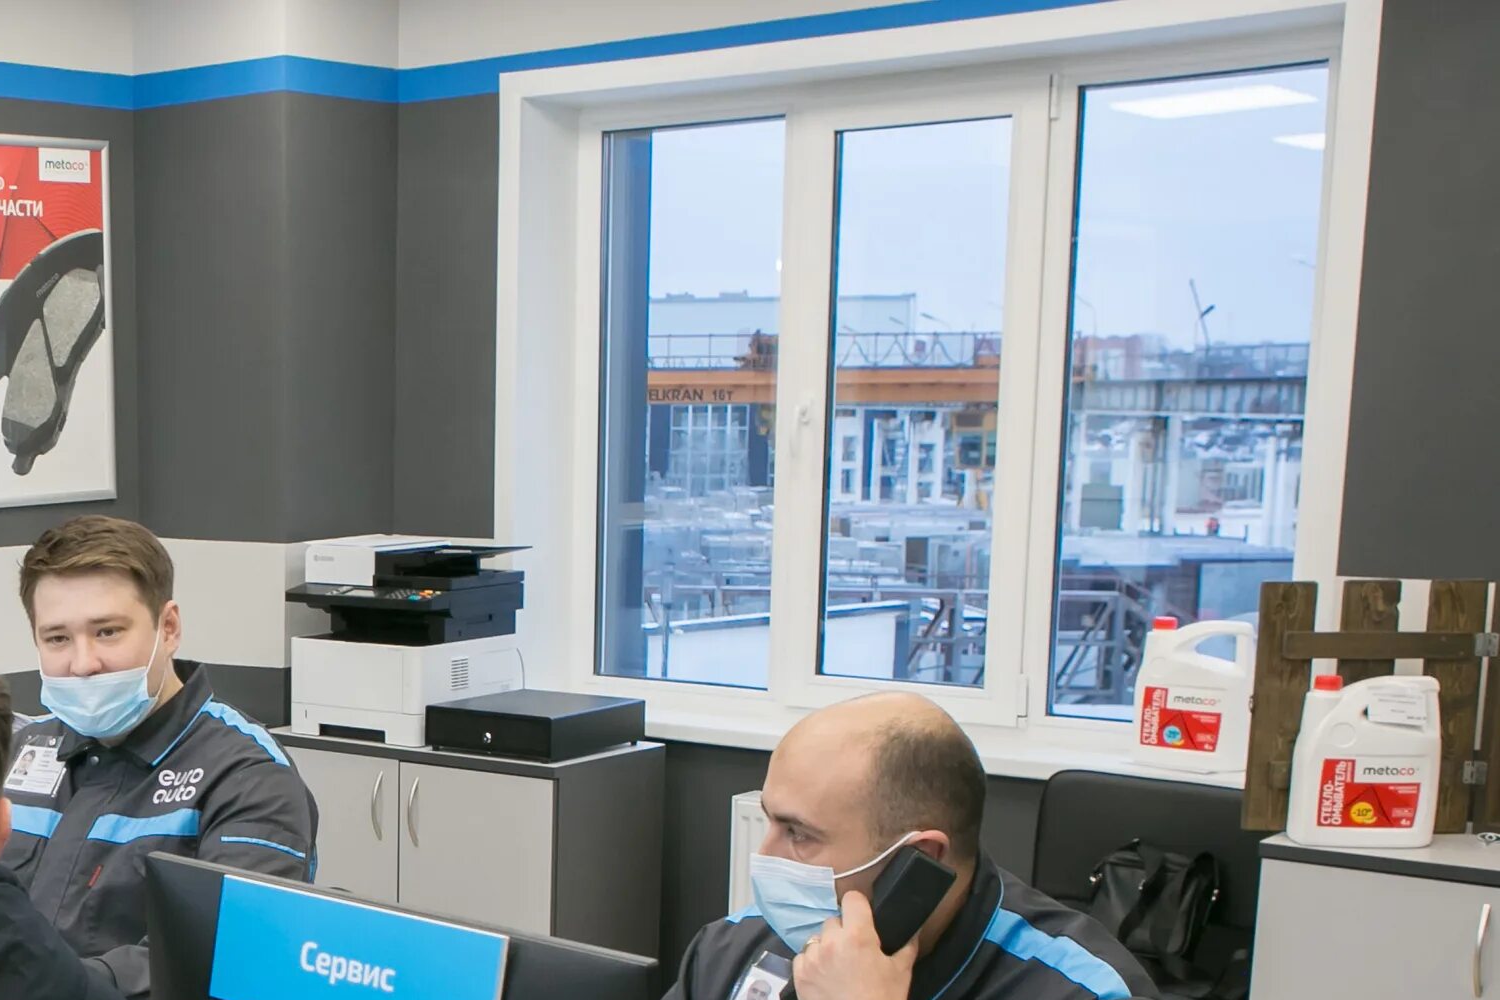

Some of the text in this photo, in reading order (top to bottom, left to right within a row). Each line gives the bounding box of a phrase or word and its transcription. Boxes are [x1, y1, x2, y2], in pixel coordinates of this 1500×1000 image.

[44, 159, 85, 172] metaco
[1173, 695, 1217, 706] metaco
[158, 767, 204, 787] euro
[1363, 766, 1415, 776] metaco
[152, 785, 197, 804] auto
[1331, 760, 1347, 825] ОМЫВАТЕЛЬ
[1320, 780, 1334, 825] СТЕКЛО-
[300, 941, 396, 992] Сервис
